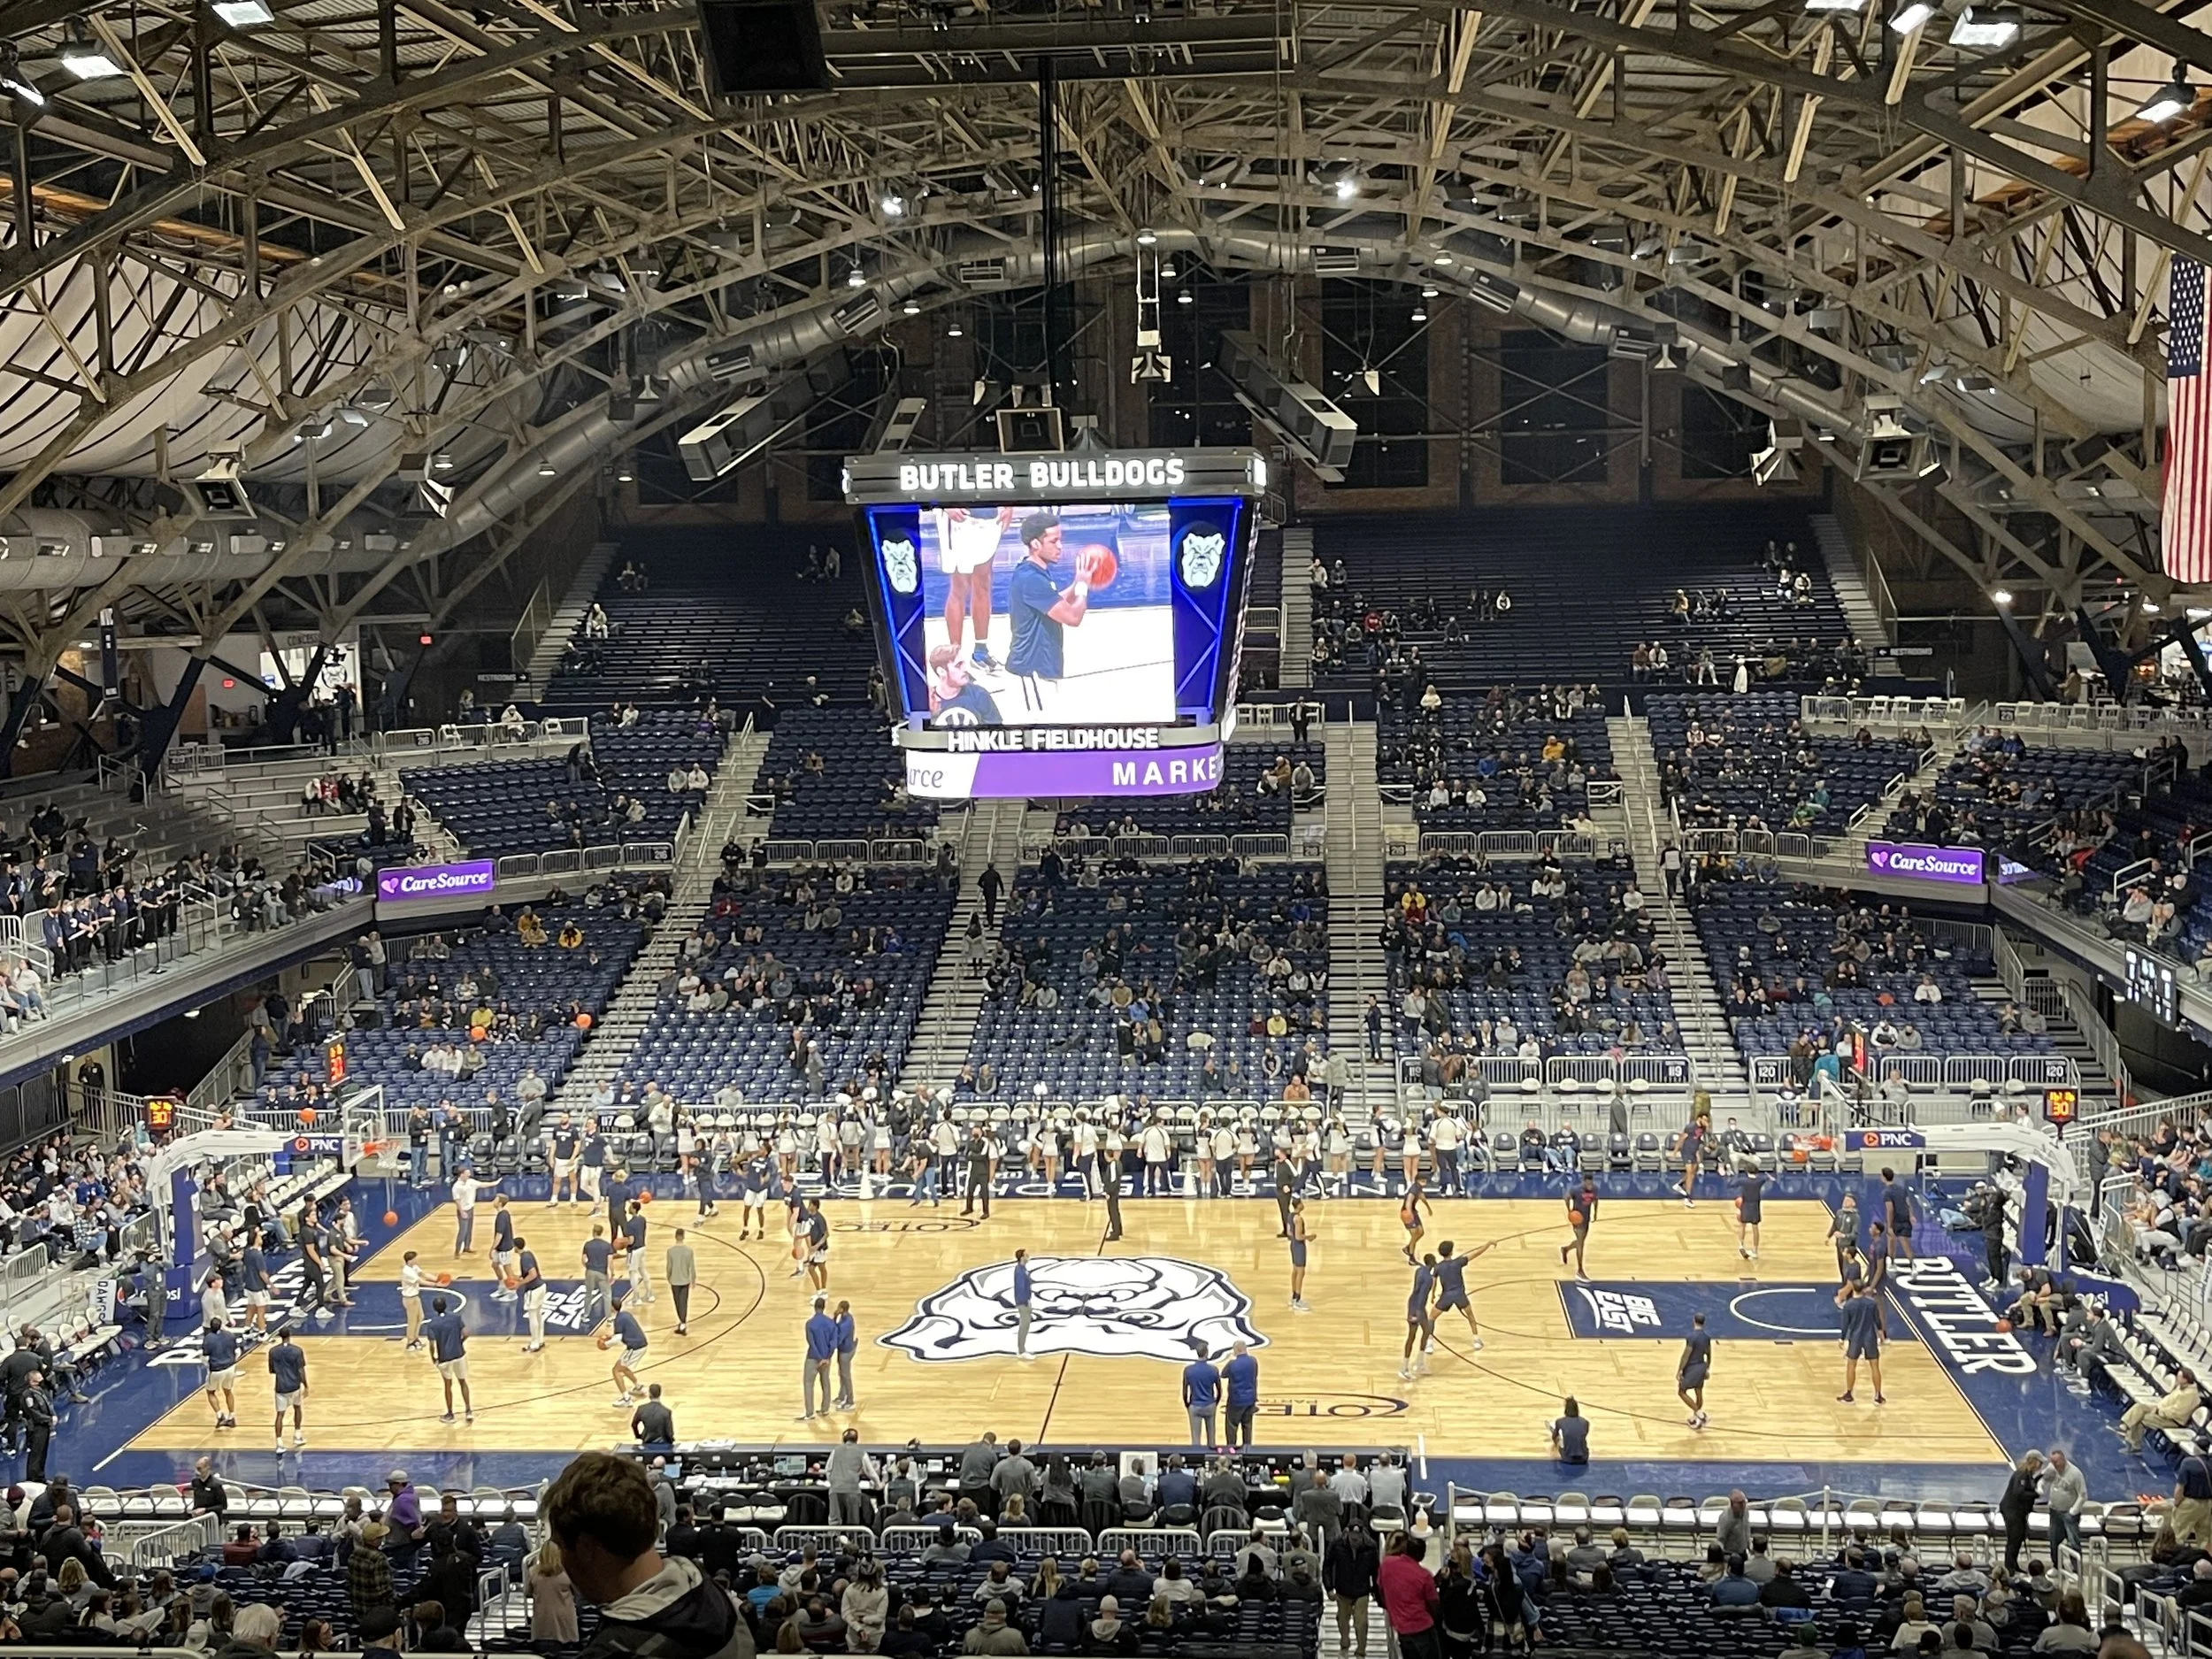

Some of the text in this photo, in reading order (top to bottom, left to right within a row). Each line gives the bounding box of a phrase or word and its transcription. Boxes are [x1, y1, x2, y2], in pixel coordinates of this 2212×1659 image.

[900, 458, 1186, 491] BUTLER BULLDOGS
[948, 728, 1159, 752] HINKLE FIELDHOUSE
[1889, 852, 1978, 876] CareSource
[401, 872, 488, 892] CareSource
[1669, 1065, 1682, 1077] 119
[1759, 1066, 1776, 1077] 120
[2046, 1065, 2064, 1077] 120
[153, 1111, 168, 1124] 30
[2053, 1102, 2070, 1117] 30
[310, 1138, 340, 1151] PNC
[1880, 1133, 1912, 1146] PNC
[1594, 1290, 1634, 1333] EAST
[1622, 1294, 1662, 1326] BIG
[1886, 1256, 2038, 1373] BUTLER
